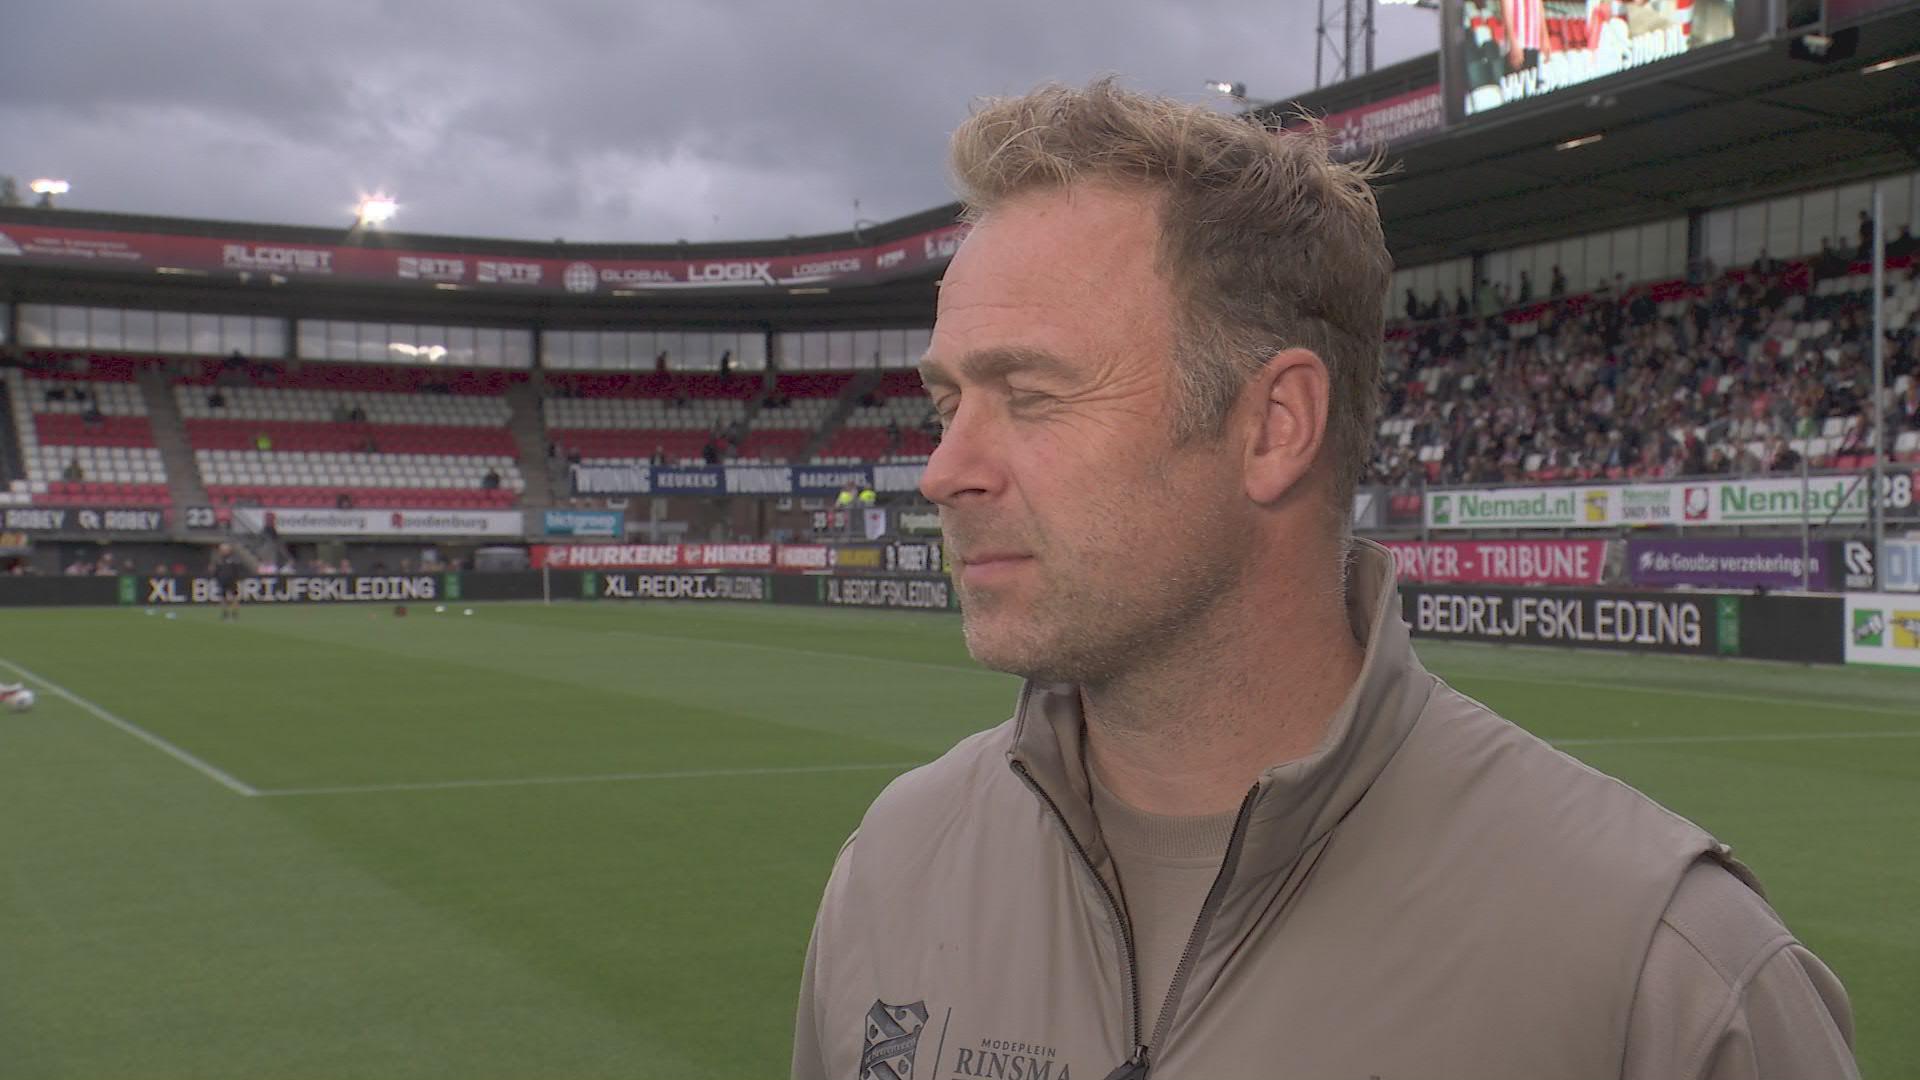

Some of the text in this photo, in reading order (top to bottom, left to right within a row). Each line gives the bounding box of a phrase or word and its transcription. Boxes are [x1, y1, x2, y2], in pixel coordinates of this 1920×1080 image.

[601, 268, 674, 282] GLOBAL
[687, 262, 774, 285] LOGIX
[792, 257, 861, 276] LOGISTICS
[1458, 491, 1576, 518] Nemad.nl
[186, 508, 215, 527] 23
[570, 545, 678, 566] HURKENS
[703, 544, 771, 565] HURKENS
[1478, 546, 1590, 579] TRIBUNE
[1671, 553, 1718, 572] Goudse
[1720, 554, 1819, 577] verzekeringn
[150, 578, 186, 602] XL
[604, 574, 634, 597] XL
[1417, 594, 1700, 646] BEDRIJFSKLEDING
[981, 1038, 1056, 1058] MODEPLEIN
[953, 1047, 1071, 1080] RINSMA
